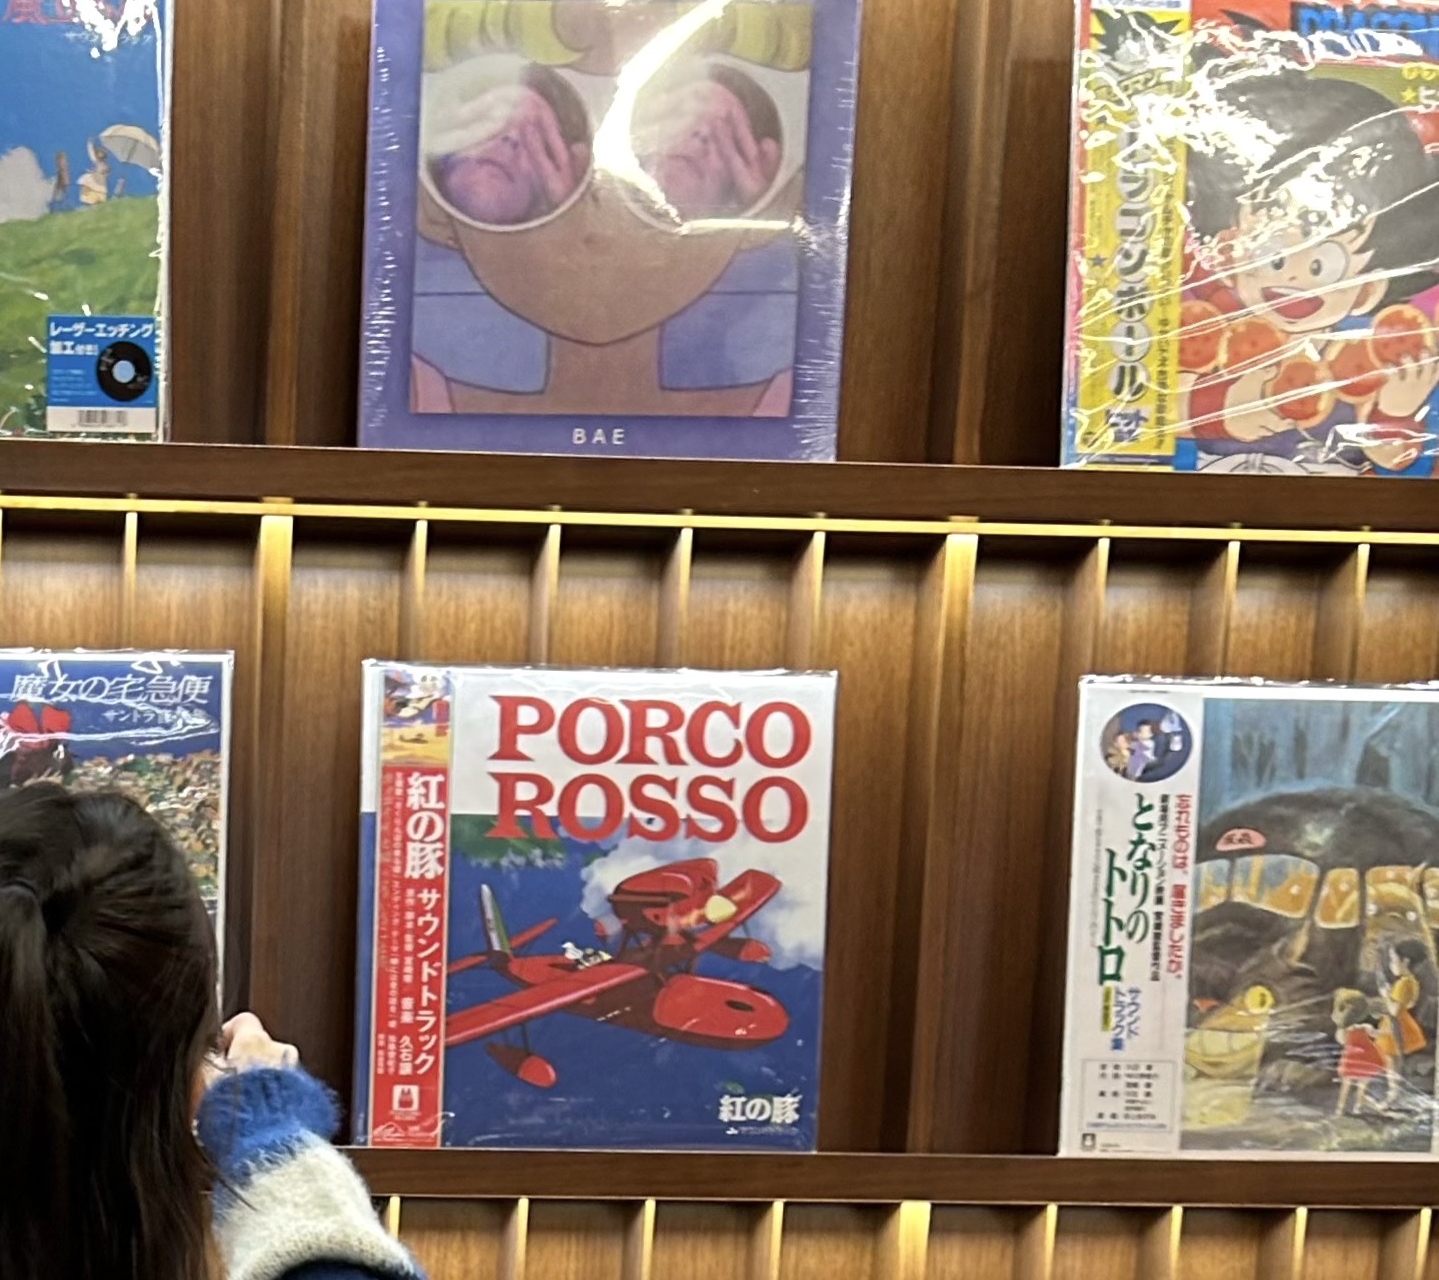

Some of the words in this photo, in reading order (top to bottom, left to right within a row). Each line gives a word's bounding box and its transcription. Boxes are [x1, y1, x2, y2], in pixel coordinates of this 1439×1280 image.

[49, 321, 154, 338] レーザーエッチング
[572, 428, 626, 446] BAE
[12, 674, 213, 705] 魔女の宅急便
[487, 694, 812, 769] PORCO
[404, 771, 446, 880] 紅の豚
[486, 772, 810, 844] ROSSO
[1125, 792, 1157, 944] となりの
[1098, 848, 1128, 986] トトロ
[414, 887, 442, 1076] サウンドトラック
[718, 1093, 801, 1125] 紅の豚
